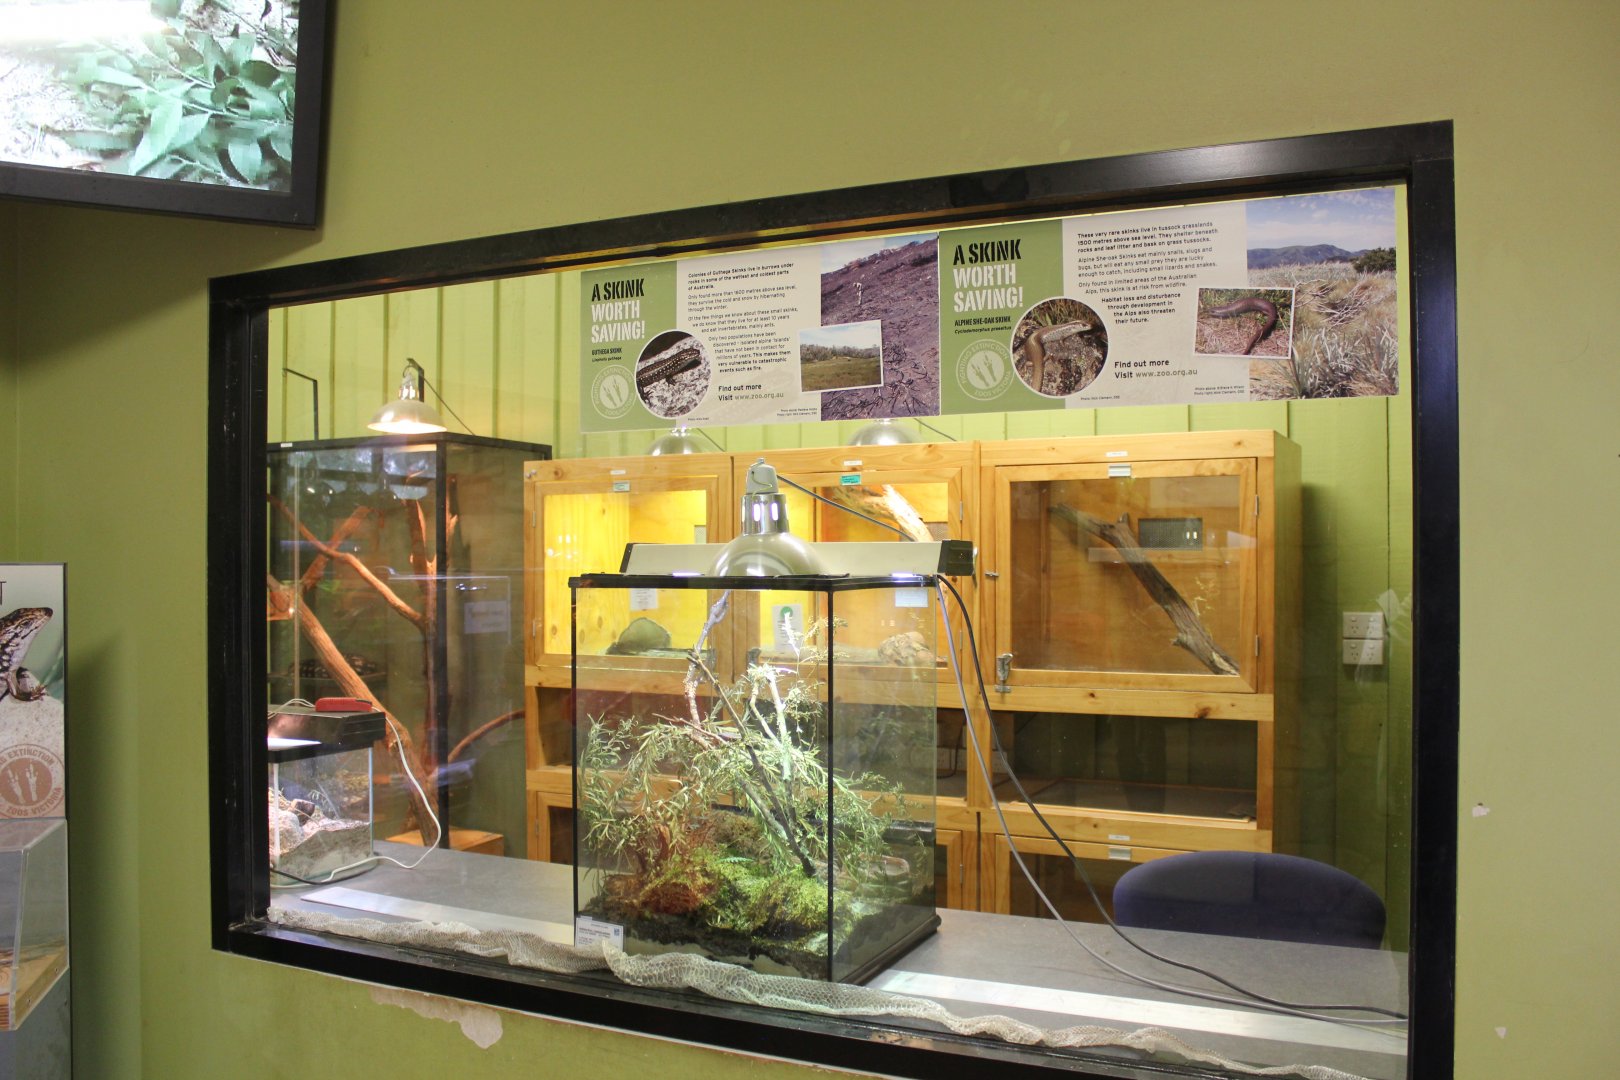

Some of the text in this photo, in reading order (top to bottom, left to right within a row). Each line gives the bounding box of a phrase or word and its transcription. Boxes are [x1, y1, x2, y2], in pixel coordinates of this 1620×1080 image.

[1182, 221, 1213, 230] grasslands
[953, 239, 1021, 265] A SKINK
[953, 264, 1016, 288] WORTH
[592, 278, 644, 301] A SKINK
[954, 287, 1023, 313] SAVING!
[591, 300, 640, 322] WORTH
[955, 318, 972, 326] ALPINE
[591, 320, 645, 344] SAVING!
[1135, 369, 1198, 378] www.zoo.org.au
[8, 748, 54, 765] EXTINCTION
[7, 787, 62, 816] ZOOS VICTORIA
